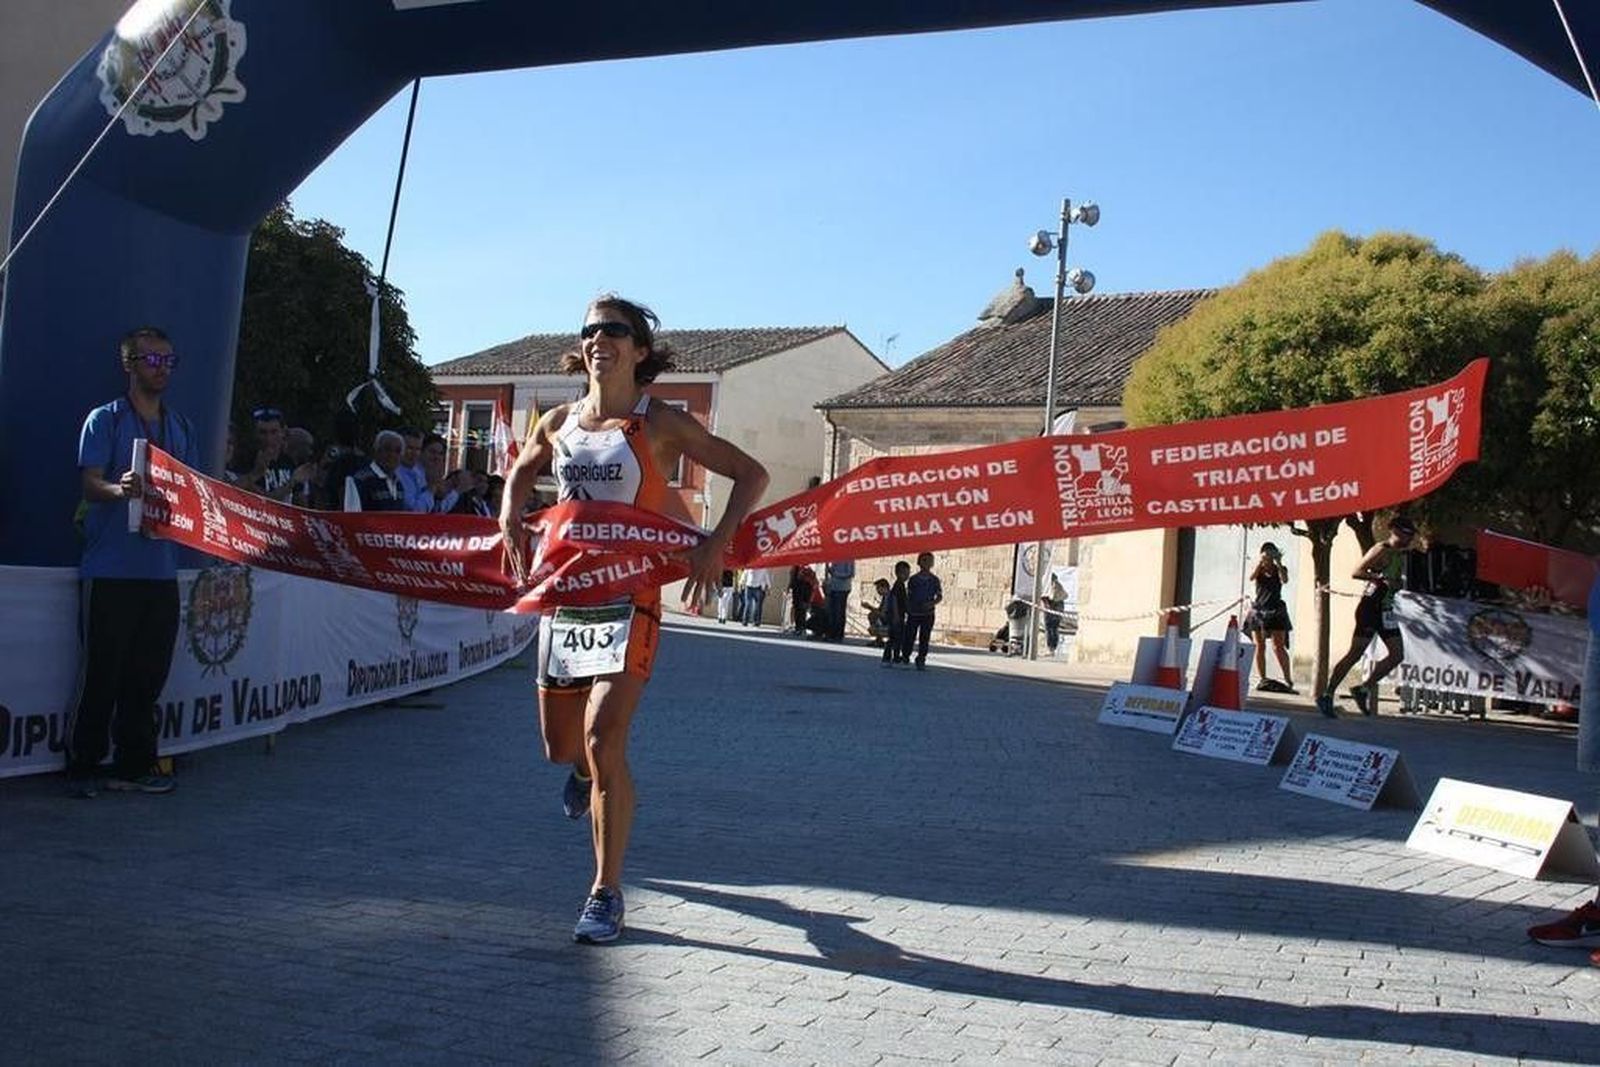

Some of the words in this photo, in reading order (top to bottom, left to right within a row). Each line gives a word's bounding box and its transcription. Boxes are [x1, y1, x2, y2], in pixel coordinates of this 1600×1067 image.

[1151, 431, 1306, 465] FEDERACIÓN
[1315, 427, 1347, 447] DE
[1409, 399, 1425, 491] TRIATLON
[561, 461, 623, 482] RODRÍGUEZ
[987, 459, 1018, 476] DE
[1194, 460, 1315, 487] TRIATLÓN
[875, 487, 990, 513] TRIATLÓN
[1053, 444, 1078, 530] TRIATLON
[1147, 493, 1263, 515] CASTILLA
[1272, 491, 1287, 507] Y
[1295, 481, 1359, 504] LEÓN
[1077, 496, 1133, 509] CASTILLA
[1079, 510, 1087, 519] Y
[559, 518, 699, 547] FEDERACIÓN
[833, 519, 943, 544] CASTILLA
[950, 517, 965, 532] Y
[972, 509, 1035, 531] LEÓN
[356, 532, 461, 551] FEDERACIÓN
[467, 535, 496, 551] DE
[387, 554, 465, 576] TRIATLÓN
[553, 555, 654, 593] CASTILLA
[375, 571, 448, 590] CASTILLA
[563, 625, 615, 652] 403
[1479, 671, 1505, 692] DE
[191, 694, 222, 736] DE
